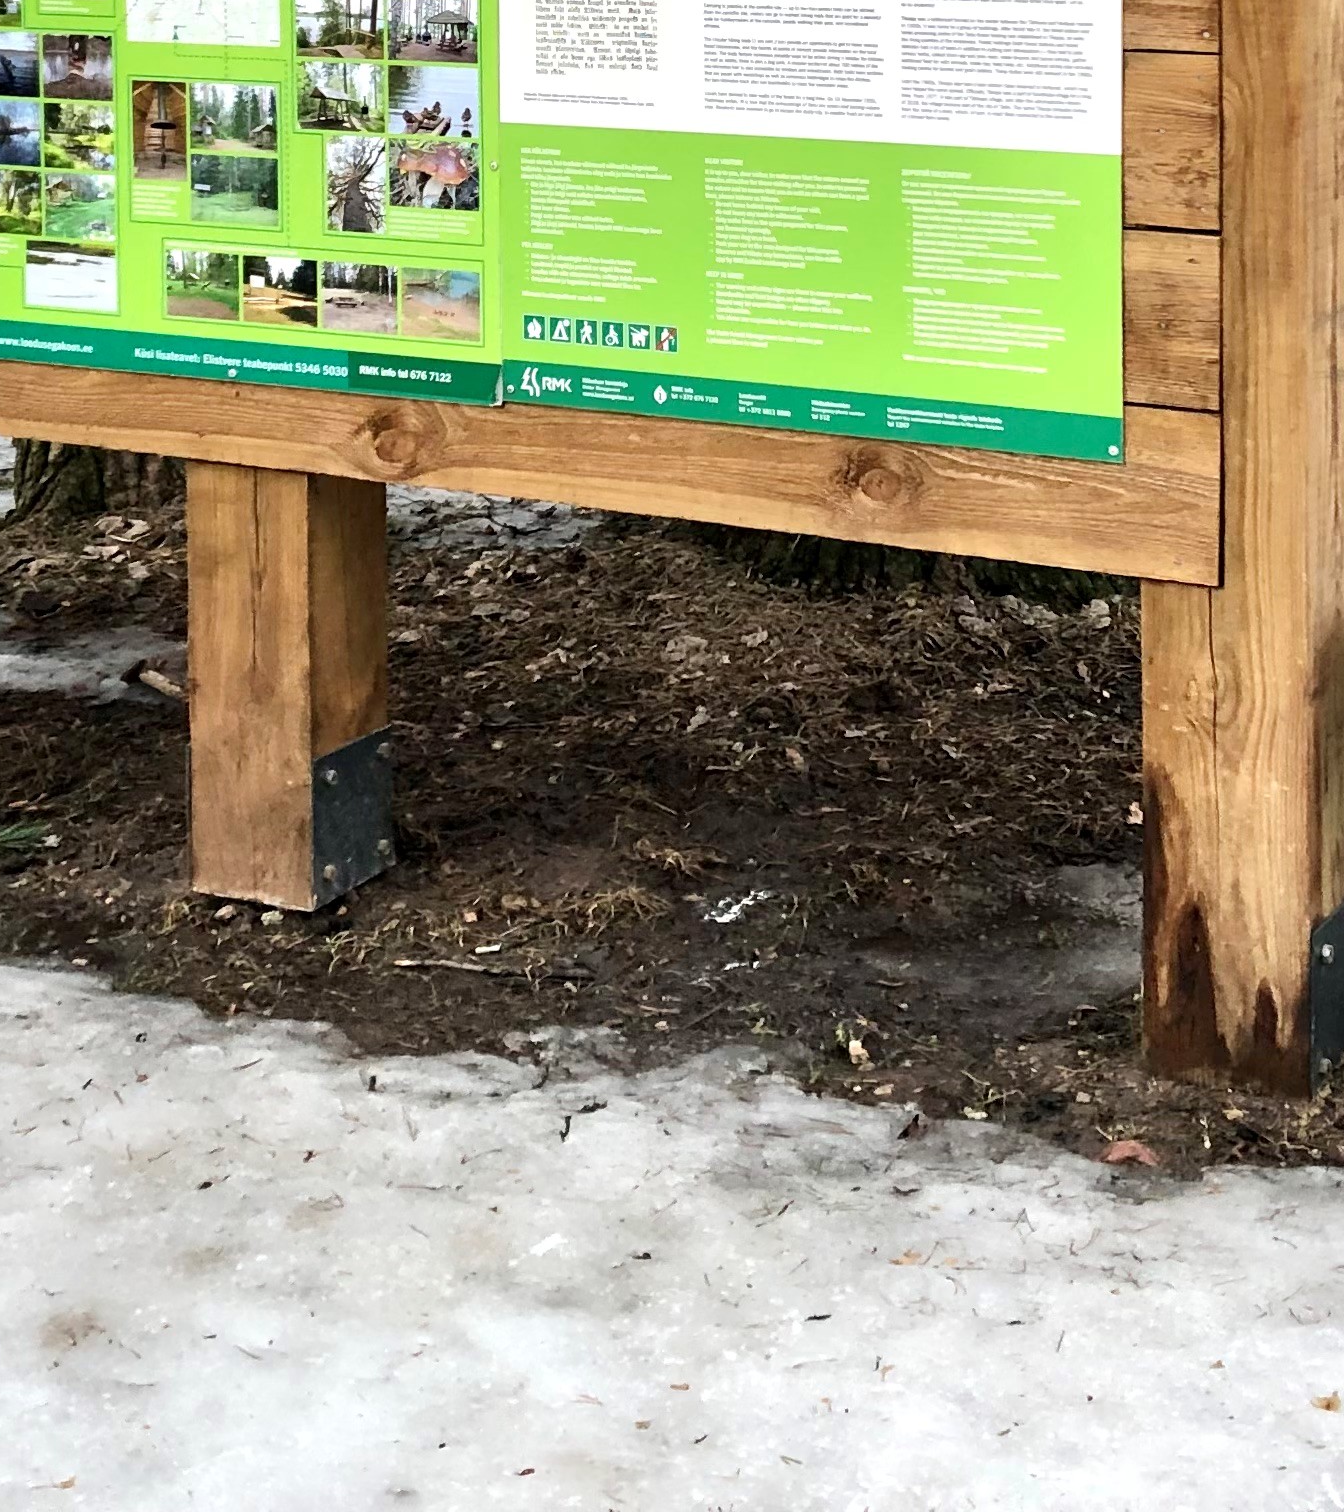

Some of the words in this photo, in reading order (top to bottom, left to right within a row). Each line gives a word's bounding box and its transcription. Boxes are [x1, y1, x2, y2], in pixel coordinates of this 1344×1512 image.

[243, 357, 294, 374] teabepunkt
[295, 362, 320, 375] 5346
[322, 364, 349, 378] 5030
[359, 365, 379, 376] RMK
[380, 367, 396, 378] info
[410, 369, 427, 381] 676
[429, 371, 452, 383] 7122
[542, 376, 572, 393] RMK
